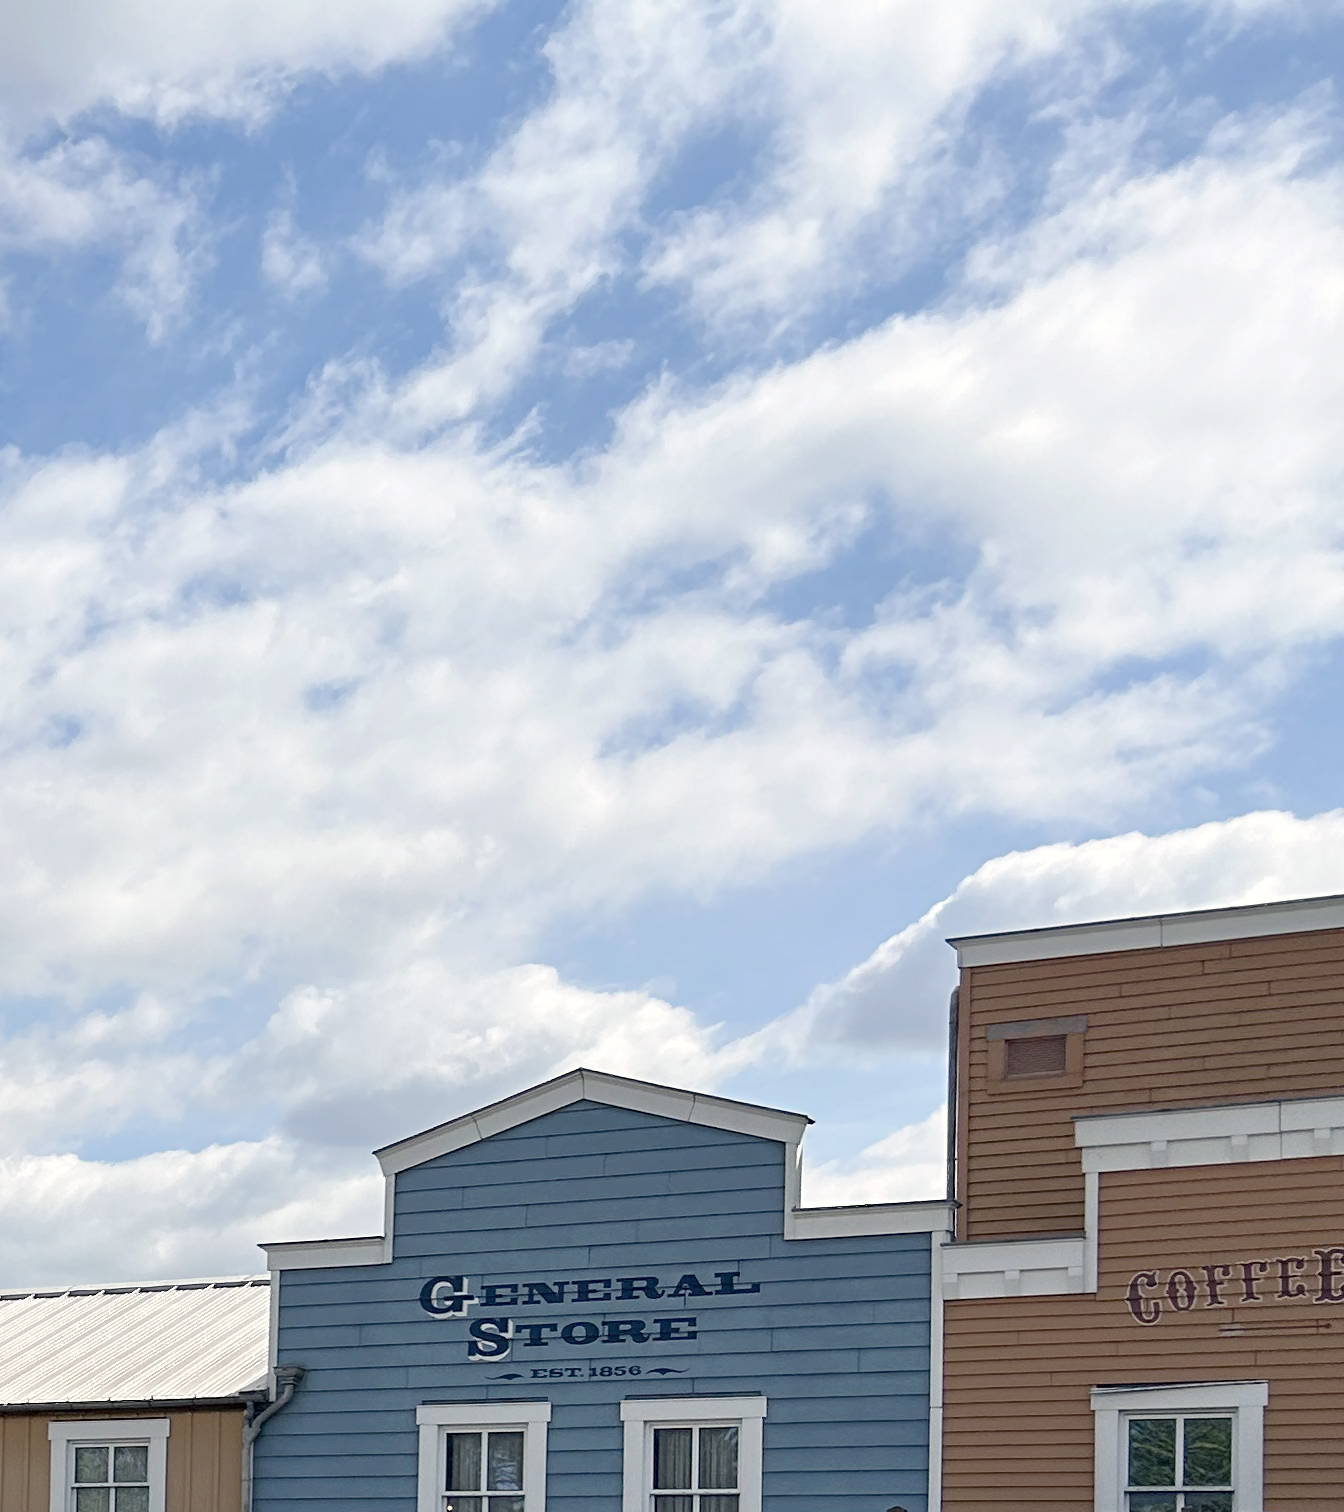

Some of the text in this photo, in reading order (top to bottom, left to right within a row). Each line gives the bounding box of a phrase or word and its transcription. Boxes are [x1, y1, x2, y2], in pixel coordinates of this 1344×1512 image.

[420, 1271, 761, 1319] GENERAL
[1125, 1249, 1344, 1325] COFFEE
[467, 1317, 698, 1362] STORE
[530, 1365, 642, 1380] EST. 1856
